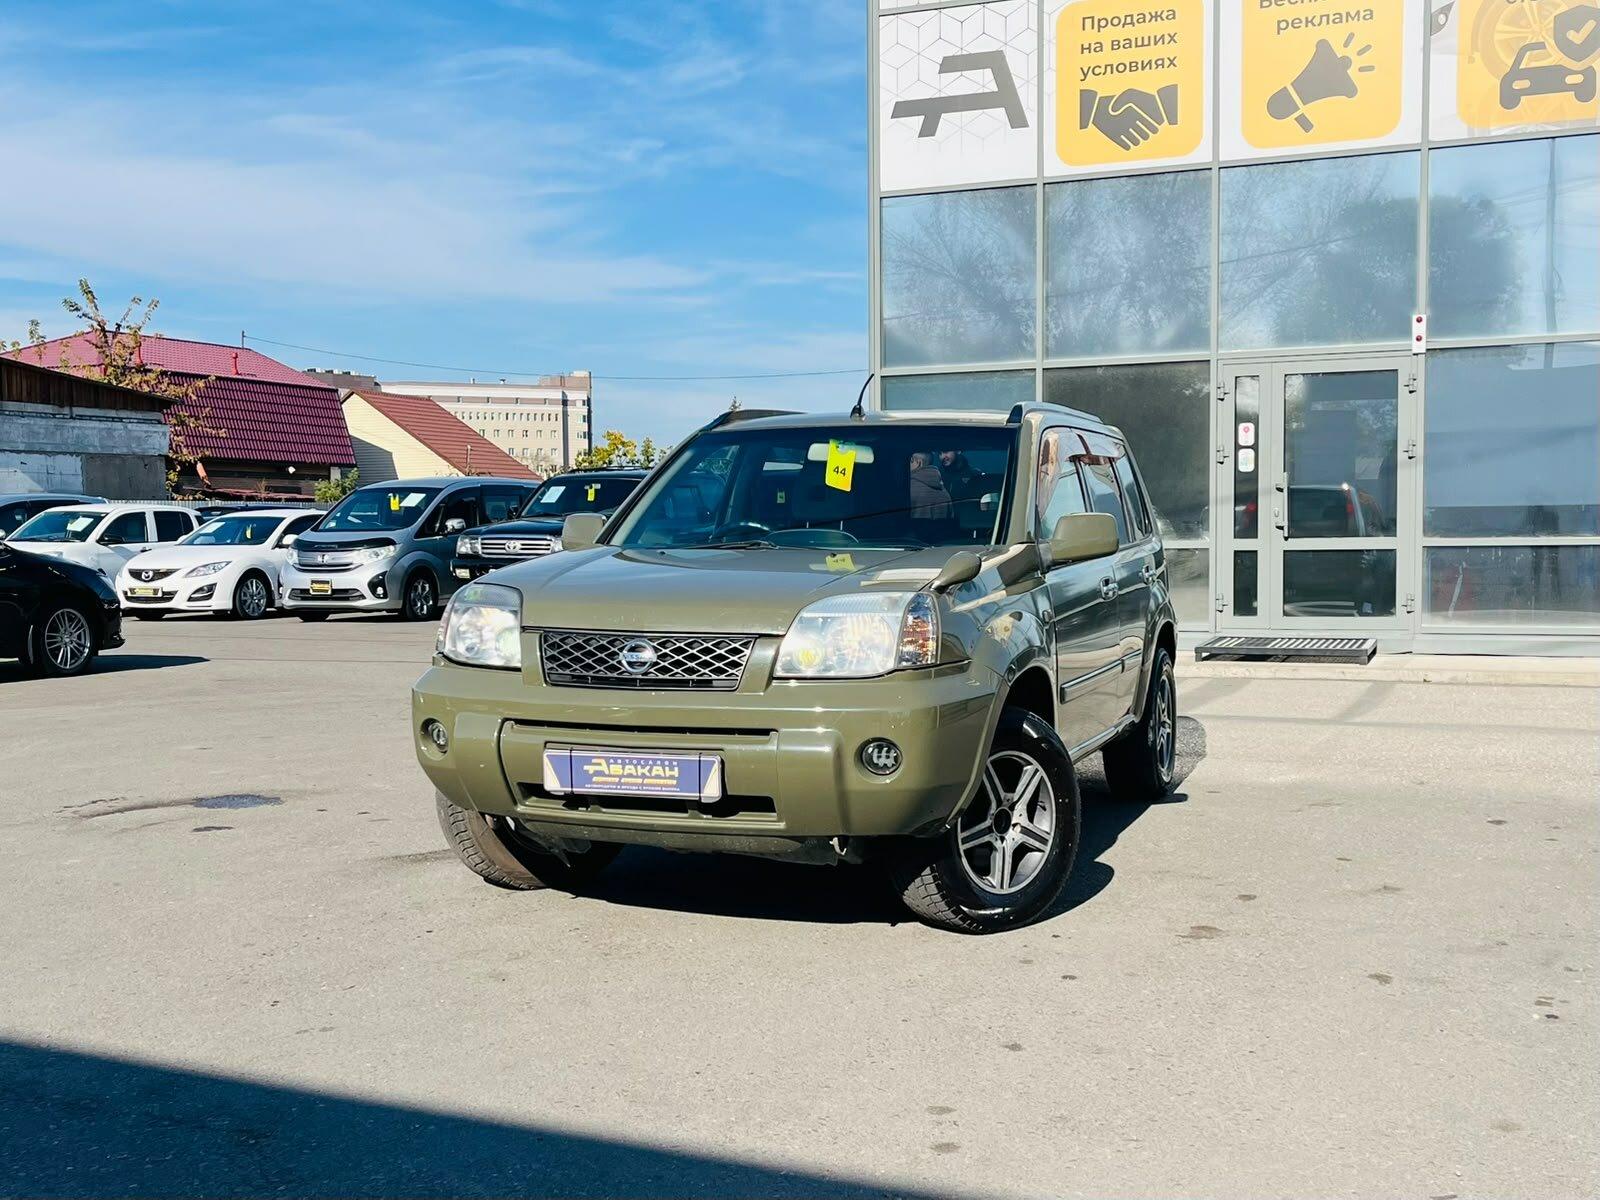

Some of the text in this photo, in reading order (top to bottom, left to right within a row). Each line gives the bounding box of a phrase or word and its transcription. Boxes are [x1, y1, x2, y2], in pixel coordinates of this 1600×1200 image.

[1081, 8, 1177, 32] Продажа
[1276, 8, 1374, 35] реклама
[1080, 32, 1178, 54] на ваших
[1080, 56, 1178, 81] условиях
[833, 465, 846, 476] 44
[583, 758, 679, 777] АБАКАН
